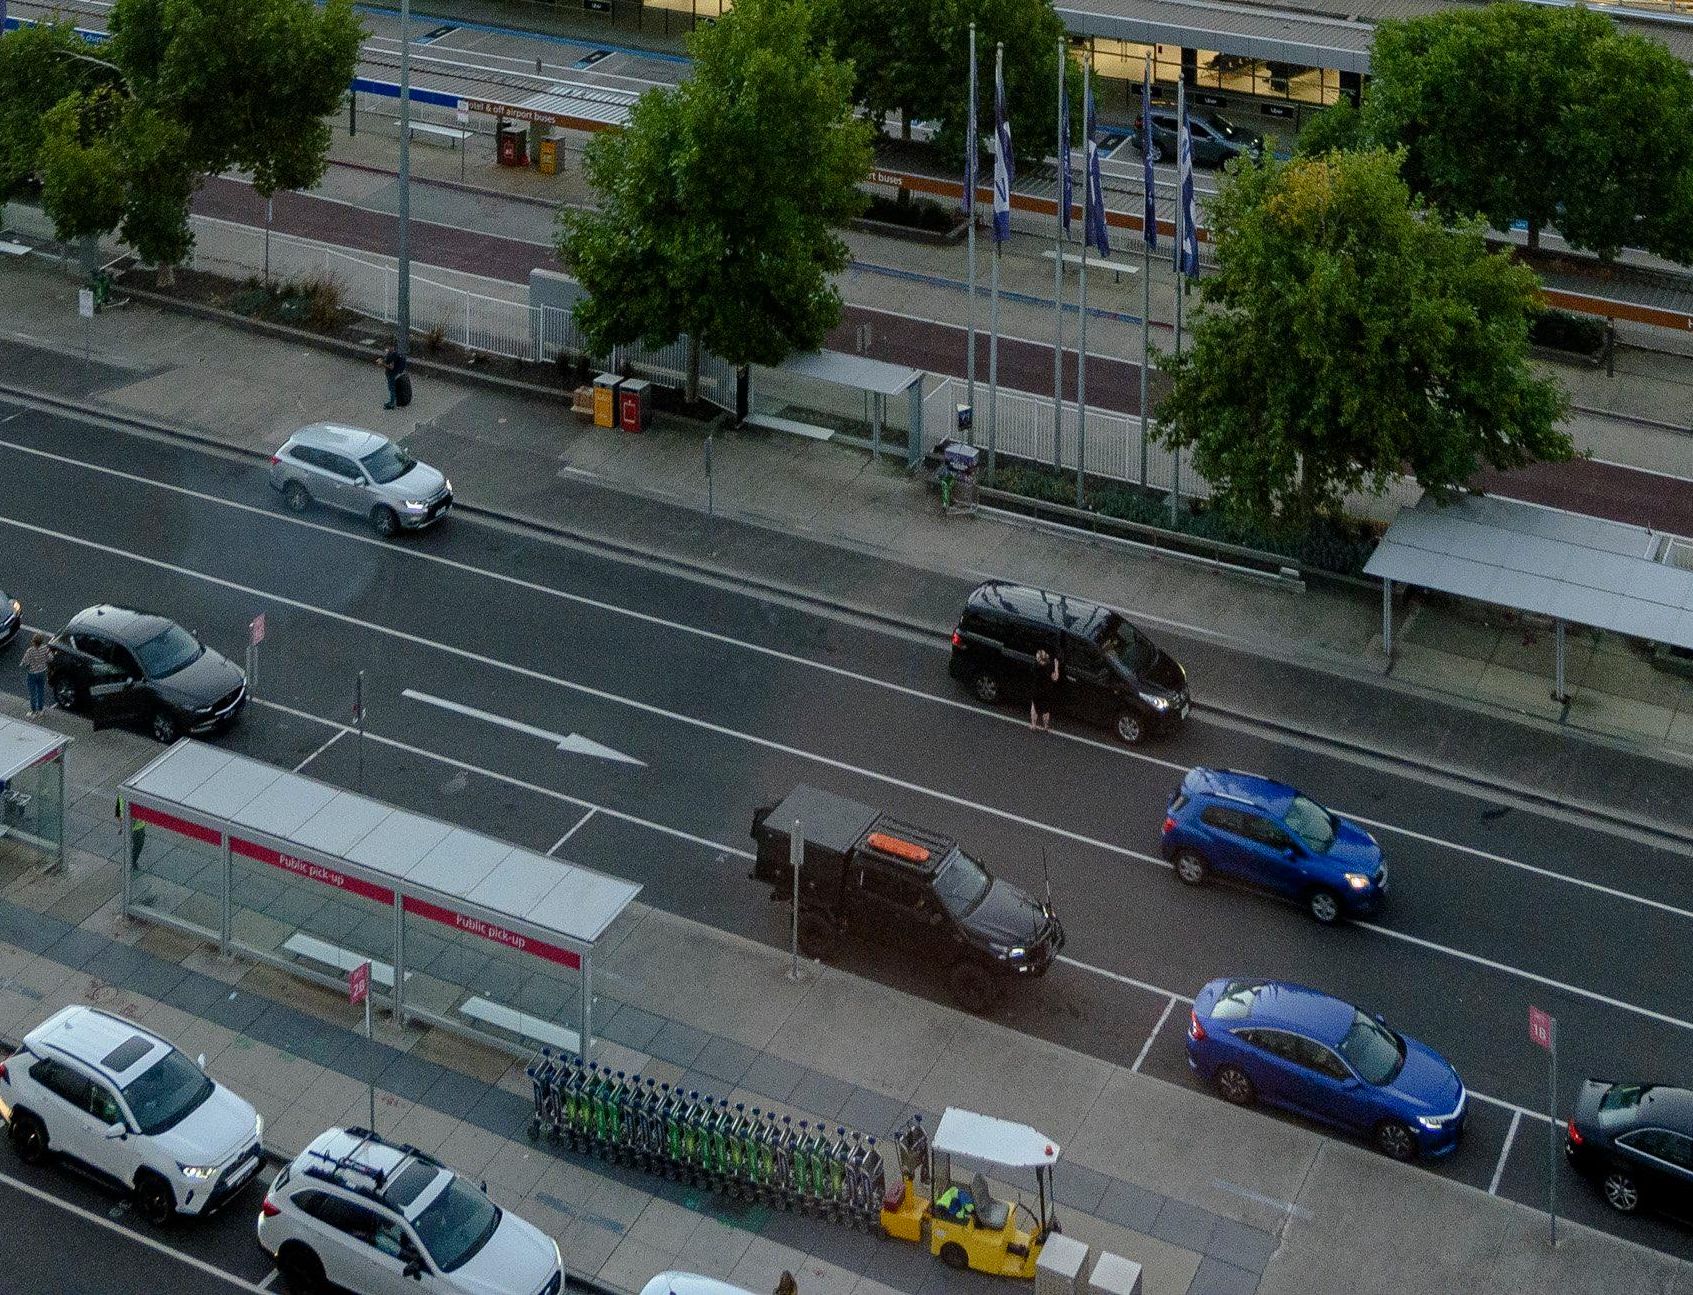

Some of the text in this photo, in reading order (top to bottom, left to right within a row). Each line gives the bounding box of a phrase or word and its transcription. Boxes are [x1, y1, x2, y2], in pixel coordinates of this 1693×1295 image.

[493, 105, 505, 115] off
[506, 108, 532, 121] airport
[534, 112, 557, 124] buses
[279, 854, 344, 886] Public pick-up
[457, 915, 526, 948] Public pick-up
